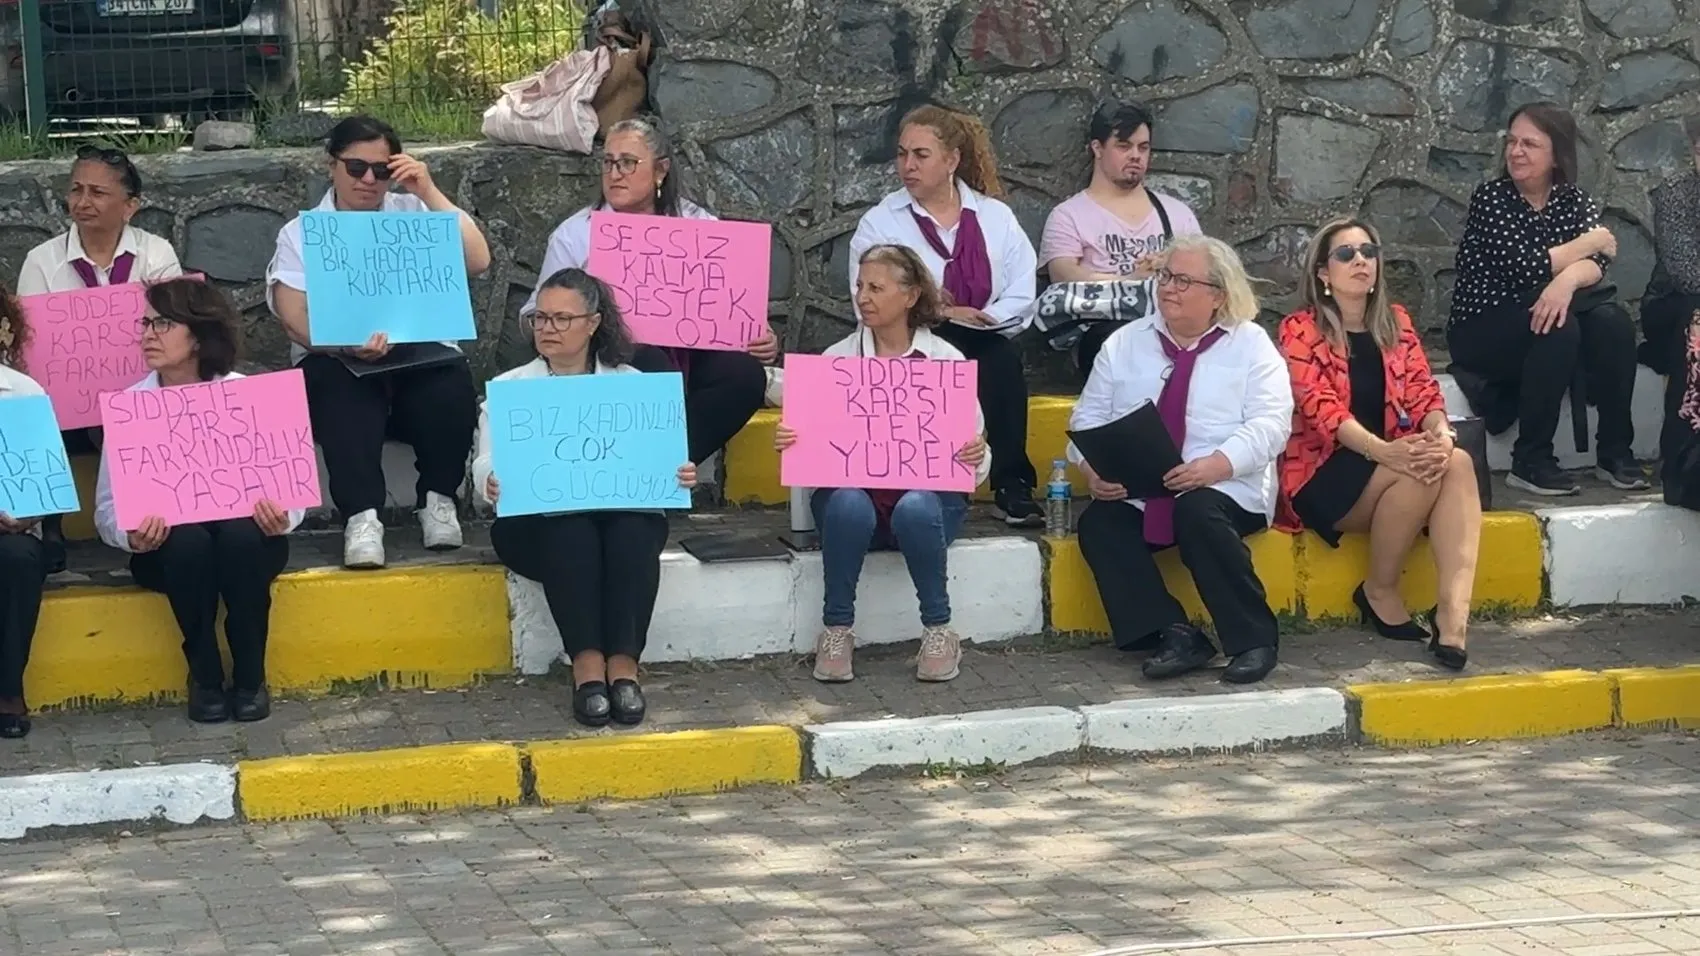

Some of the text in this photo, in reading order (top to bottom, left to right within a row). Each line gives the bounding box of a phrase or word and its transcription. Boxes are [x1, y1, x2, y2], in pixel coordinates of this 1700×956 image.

[302, 215, 454, 246] BIR ISARET
[320, 245, 435, 273] BIR HAYAT
[622, 255, 725, 288] KALMA
[347, 264, 460, 297] KURTARIR
[831, 356, 971, 389] SIDDETE
[109, 380, 242, 424] SIDDETE
[508, 406, 568, 442] BIZ
[852, 413, 940, 443] TEK
[0, 446, 67, 477] DEN
[118, 426, 315, 475] FARKINDALIK
[554, 435, 623, 464] ÇOK
[829, 440, 972, 479] YÜREK
[152, 456, 320, 515] YAŞATIR
